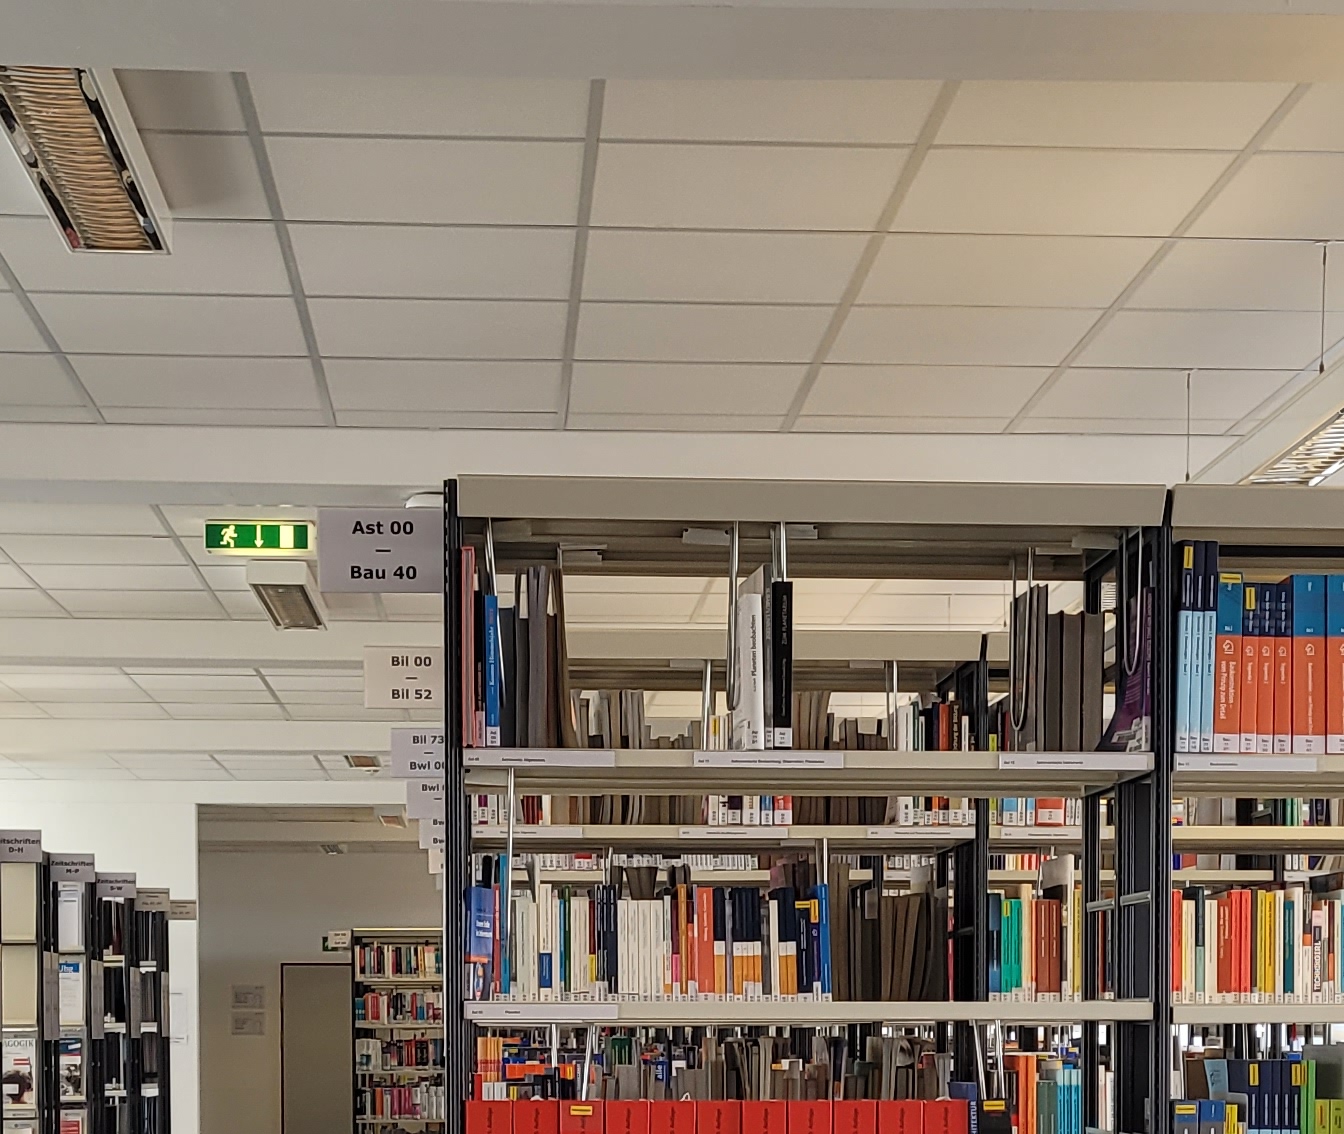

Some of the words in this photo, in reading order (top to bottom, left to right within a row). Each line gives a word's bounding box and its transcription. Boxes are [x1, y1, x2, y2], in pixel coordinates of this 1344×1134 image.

[352, 521, 383, 535] Ast
[390, 521, 414, 535] 00
[350, 565, 386, 580] Bau
[393, 565, 417, 580] 40
[391, 656, 408, 667] Bil
[414, 656, 432, 667] 00
[391, 689, 410, 700] Bil
[414, 689, 432, 700] 52
[412, 735, 427, 744] Bil
[409, 761, 430, 770] Bwl
